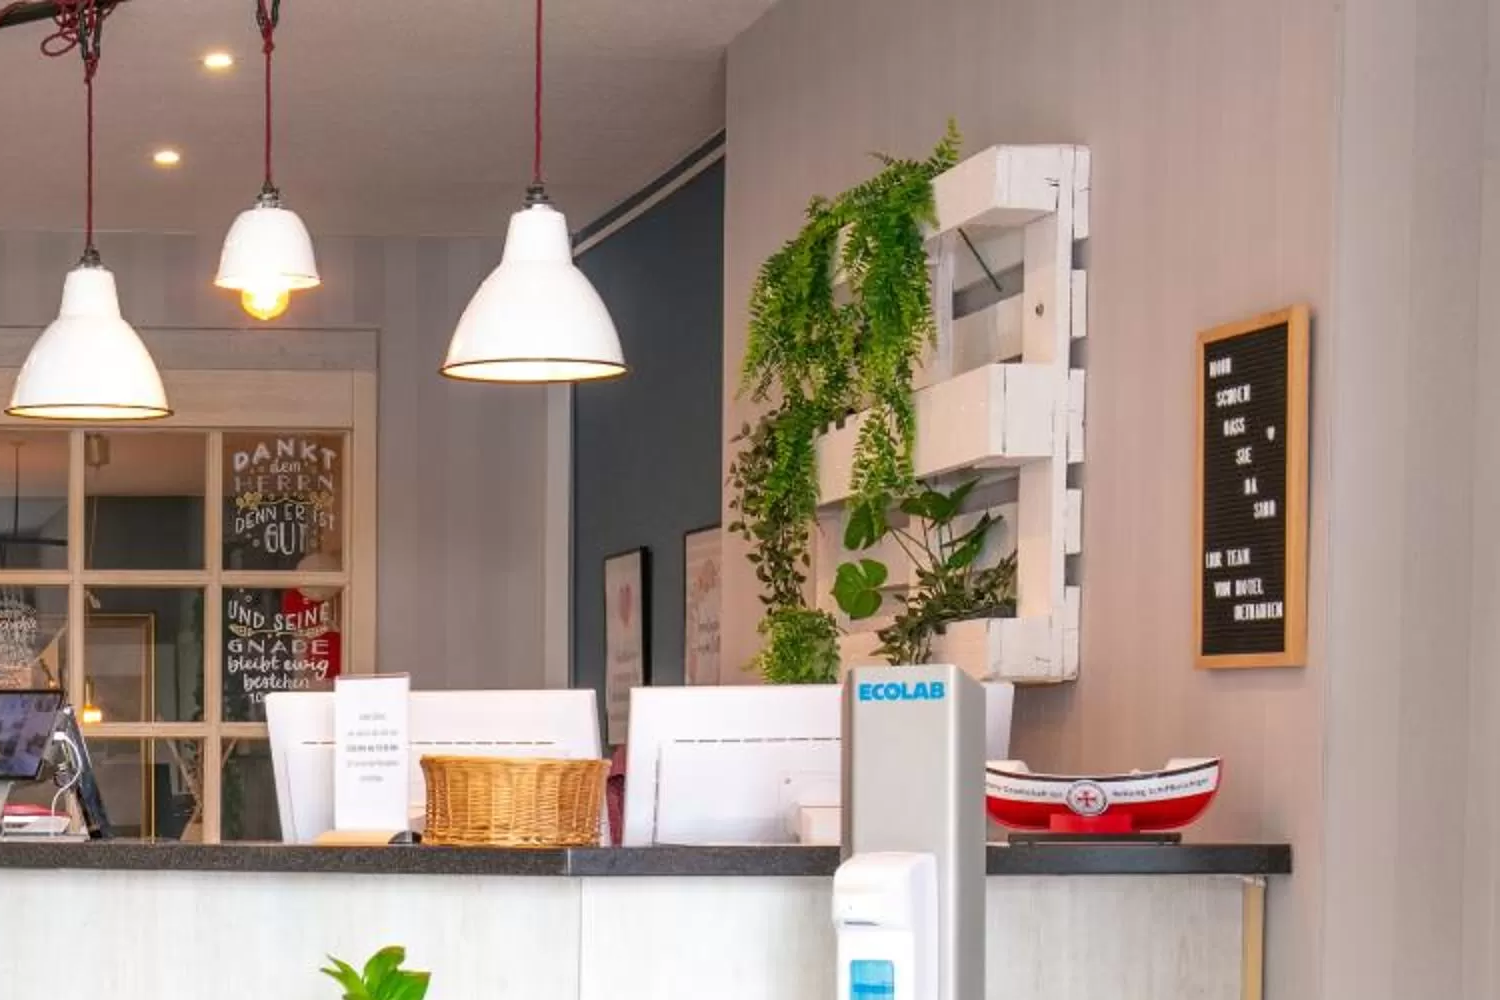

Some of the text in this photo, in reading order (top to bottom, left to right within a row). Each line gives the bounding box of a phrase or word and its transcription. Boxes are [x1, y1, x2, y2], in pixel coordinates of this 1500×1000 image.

[233, 438, 337, 473] DANKT
[234, 474, 334, 495] HERRN
[235, 503, 334, 534] DENN ER IST
[264, 521, 308, 555] GUT
[1226, 548, 1250, 567] TEAM
[1235, 577, 1264, 597] HOTEL
[227, 600, 330, 631] UND SEINE
[227, 638, 329, 655] GNADE
[227, 655, 330, 681] bleibt ewig
[243, 673, 310, 692] bestehen
[859, 681, 946, 701] ECOLAB
